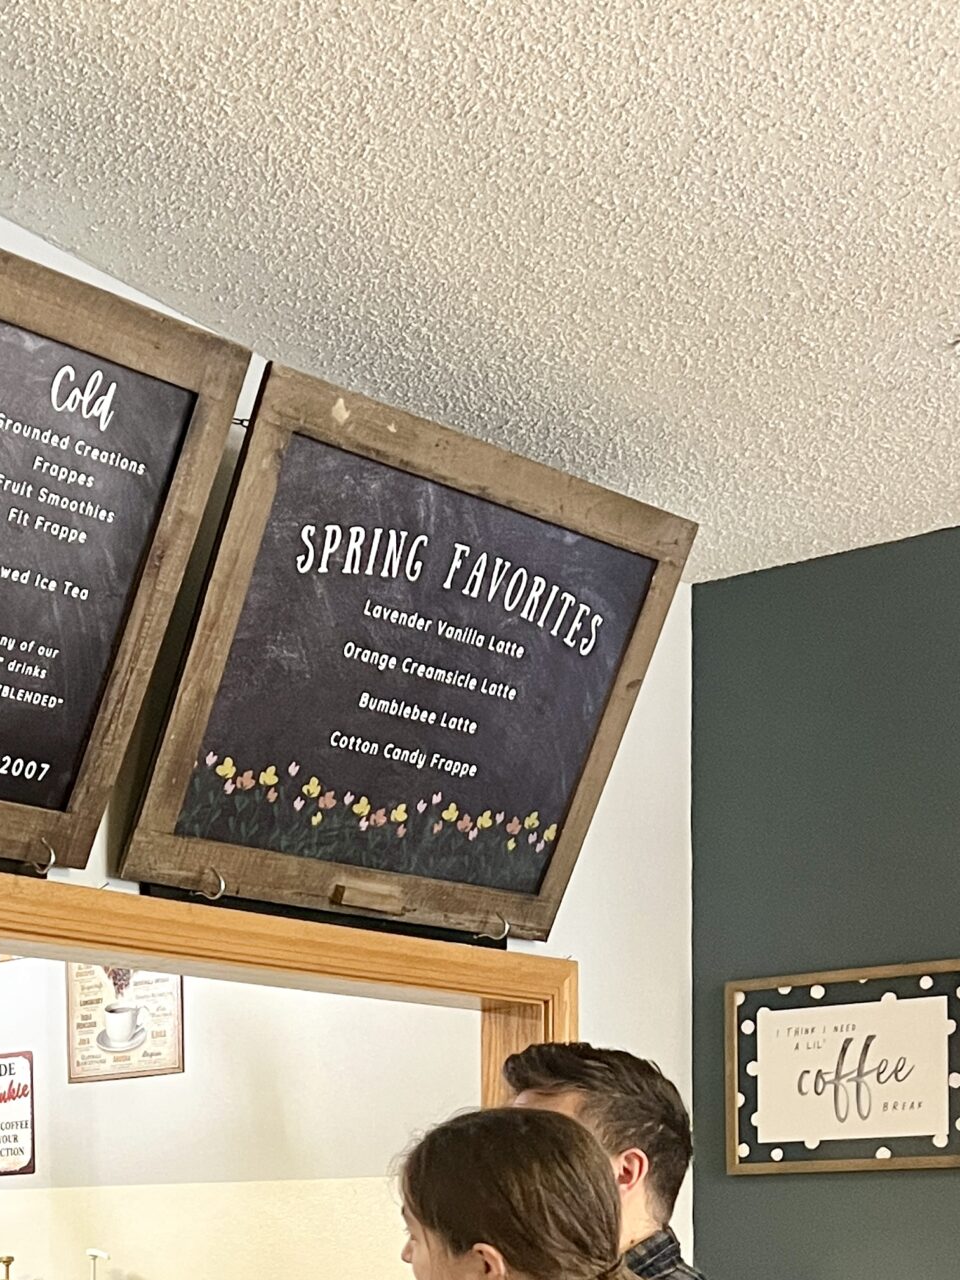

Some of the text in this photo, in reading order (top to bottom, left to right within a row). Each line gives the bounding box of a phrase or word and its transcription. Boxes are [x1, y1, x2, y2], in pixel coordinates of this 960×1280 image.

[50, 365, 117, 432] Cold
[32, 455, 95, 488] Frappes
[74, 440, 146, 476] Creations
[37, 487, 115, 524] Smoothies
[7, 507, 87, 544] Fit Frappe
[34, 573, 57, 592] Ice
[63, 581, 89, 601] Tea
[296, 524, 604, 656] SPRING FAVORITES
[363, 599, 525, 659] Lavender Vanilla Latte
[19, 640, 36, 653] of
[37, 645, 60, 659] our
[7, 659, 47, 679] drinks
[343, 641, 517, 701] Orange Creamsicle Latte
[358, 692, 478, 734] Bumblebee Latte
[330, 730, 477, 778] Cotton Candy Frappe
[786, 1026, 816, 1037] THINK
[834, 1024, 856, 1033] NEED
[794, 1042, 800, 1050] A
[798, 1034, 915, 1123] coffee
[883, 1101, 923, 1112] BREAK
[0, 1120, 29, 1130] COFFEE
